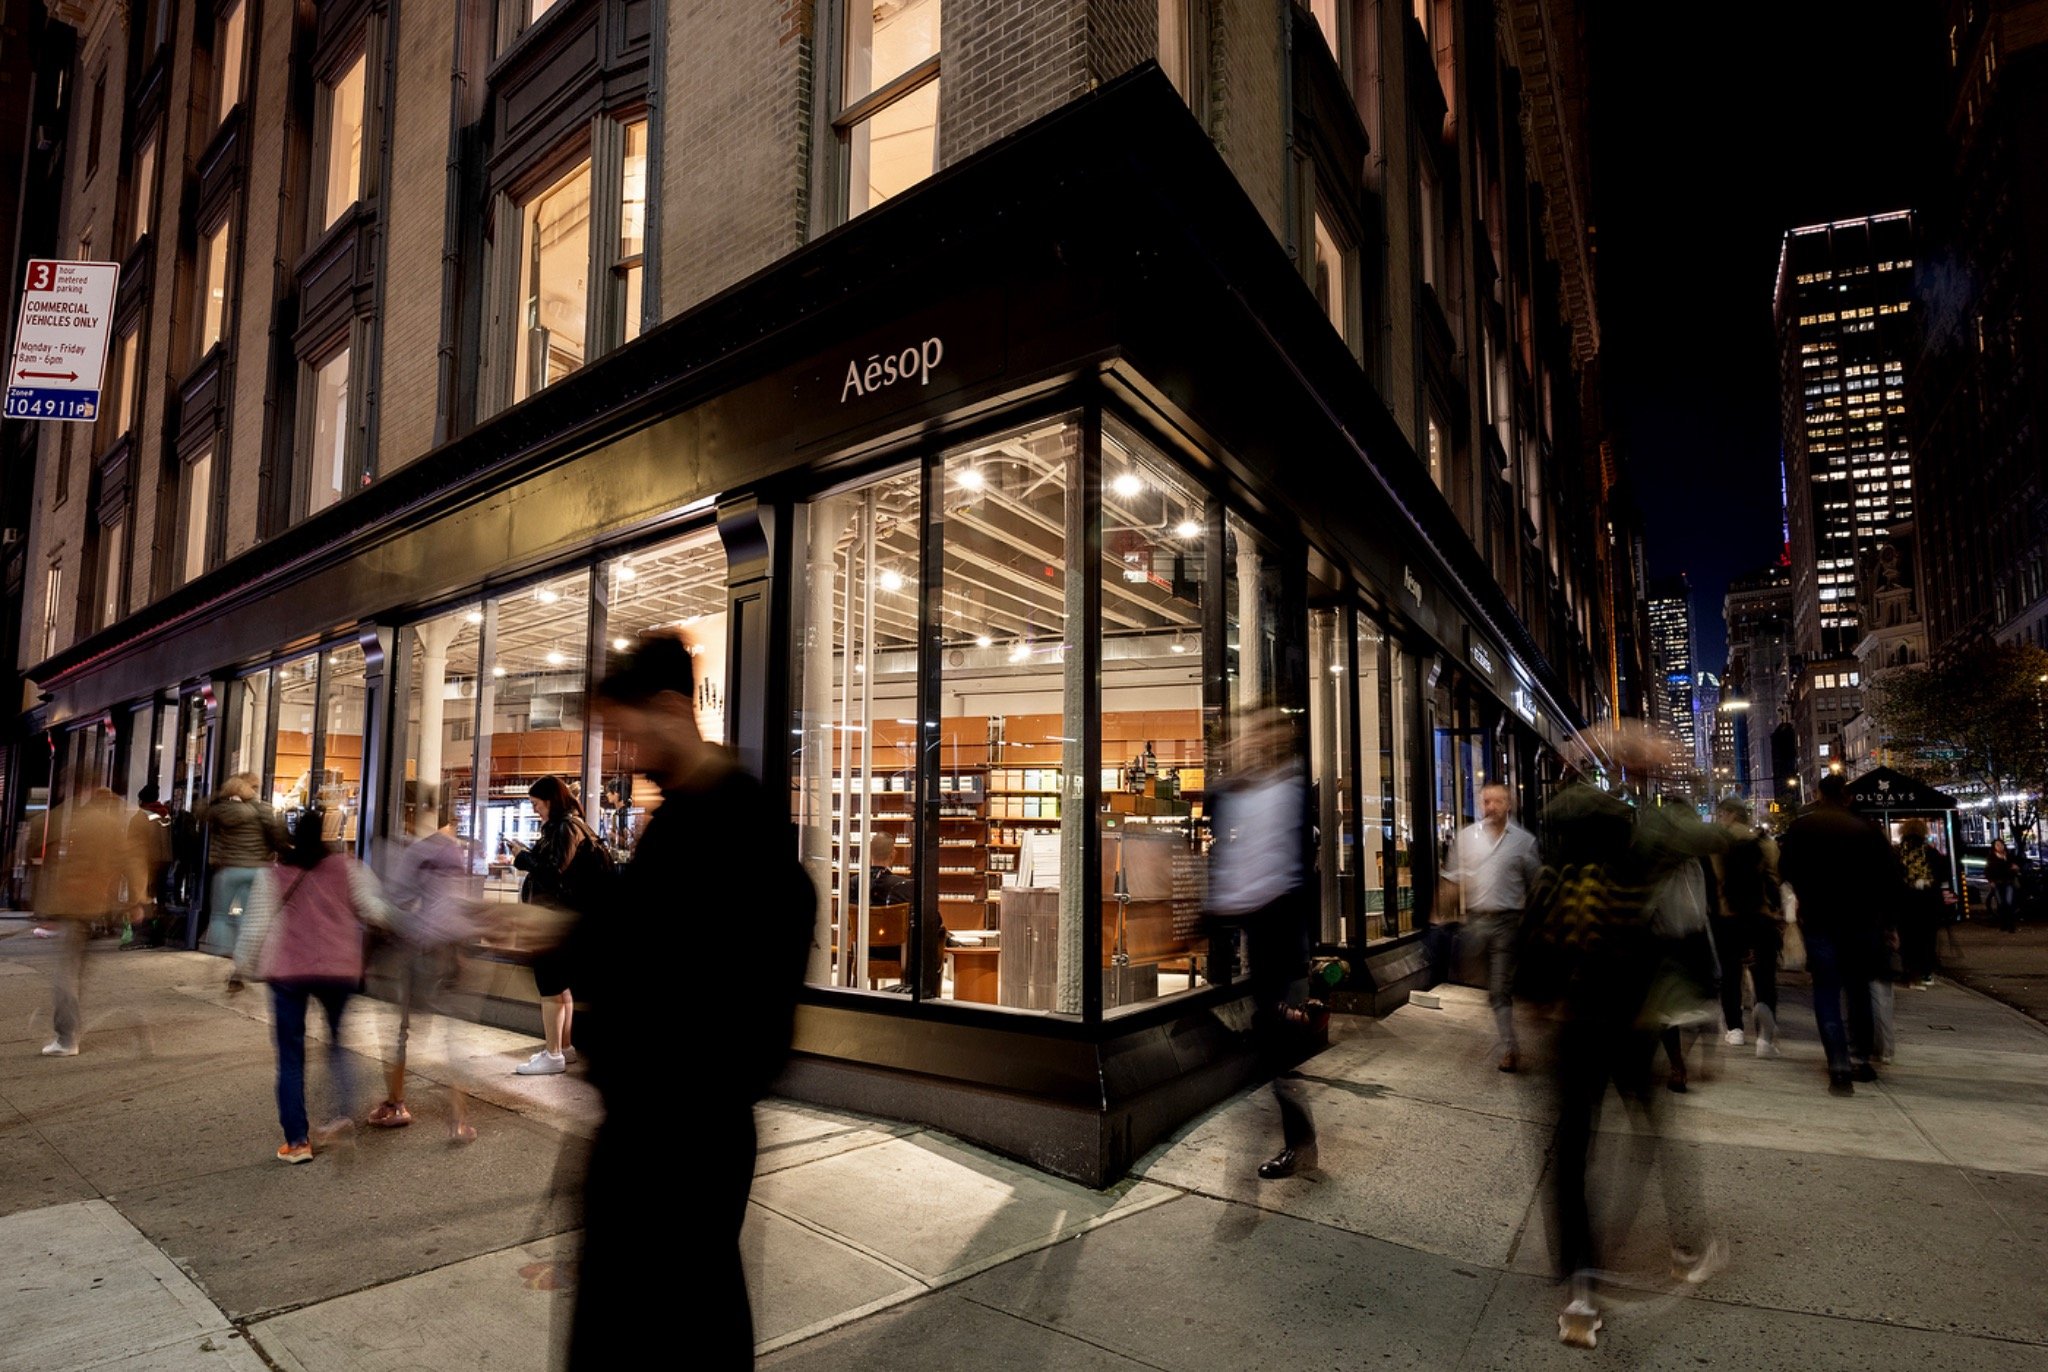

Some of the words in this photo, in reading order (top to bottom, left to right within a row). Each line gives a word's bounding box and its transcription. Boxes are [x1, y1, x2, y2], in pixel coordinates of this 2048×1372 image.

[33, 265, 49, 289] 3
[57, 286, 83, 294] parking
[27, 301, 90, 314] COMMERCIAL
[25, 315, 71, 327] VEHICLES
[73, 317, 99, 328] ONLY
[21, 342, 52, 352] Monday
[60, 344, 86, 356] Friday
[19, 353, 37, 362] 8am
[44, 354, 63, 365] 6pm
[9, 399, 74, 416] 104911
